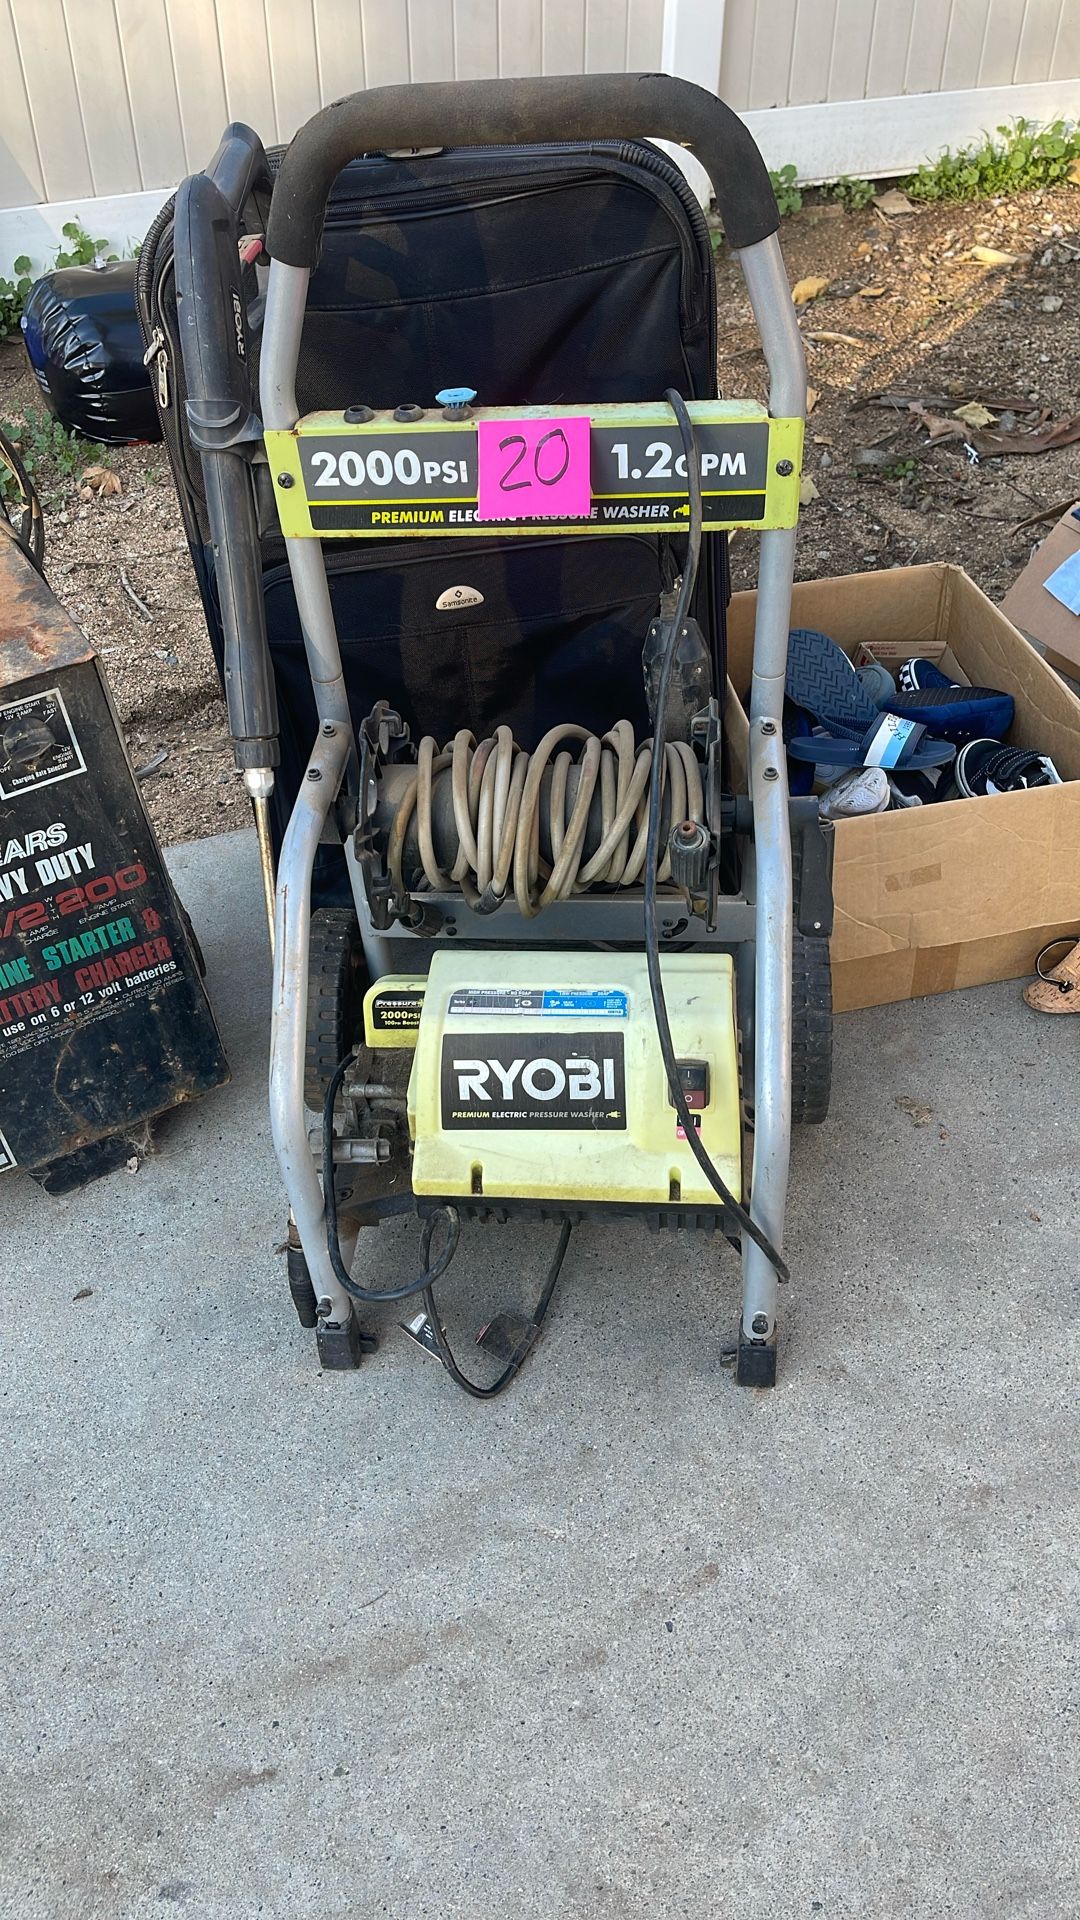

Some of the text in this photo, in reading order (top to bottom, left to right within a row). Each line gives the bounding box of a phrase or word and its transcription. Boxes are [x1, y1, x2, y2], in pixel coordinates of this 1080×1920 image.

[232, 293, 245, 355] RYOBI
[499, 428, 570, 492] 20
[371, 510, 444, 524] PREMIUM
[603, 505, 670, 519] WASHER
[42, 708, 57, 716] FAST
[0, 823, 68, 866] ARS
[0, 843, 96, 903] VY DUTY
[55, 864, 148, 916] 200
[78, 898, 136, 925] ENGINE START
[97, 899, 117, 910] AMP
[24, 928, 59, 946] CHARGE
[29, 925, 49, 936] AMP
[42, 917, 136, 971] STARTER
[142, 907, 161, 931] &
[0, 978, 62, 1025] TTERY
[74, 935, 173, 992] CHARGER
[2, 1020, 26, 1037] use
[29, 1012, 46, 1026] on
[49, 1005, 60, 1017] 6
[62, 1000, 77, 1013] or
[78, 991, 95, 1006] 12
[97, 981, 121, 998] volt
[124, 957, 177, 988] batteries
[453, 1057, 616, 1101] RYOBI
[452, 1111, 605, 1119] PREMIUM ELECTRIC PRESSURE WASHER
